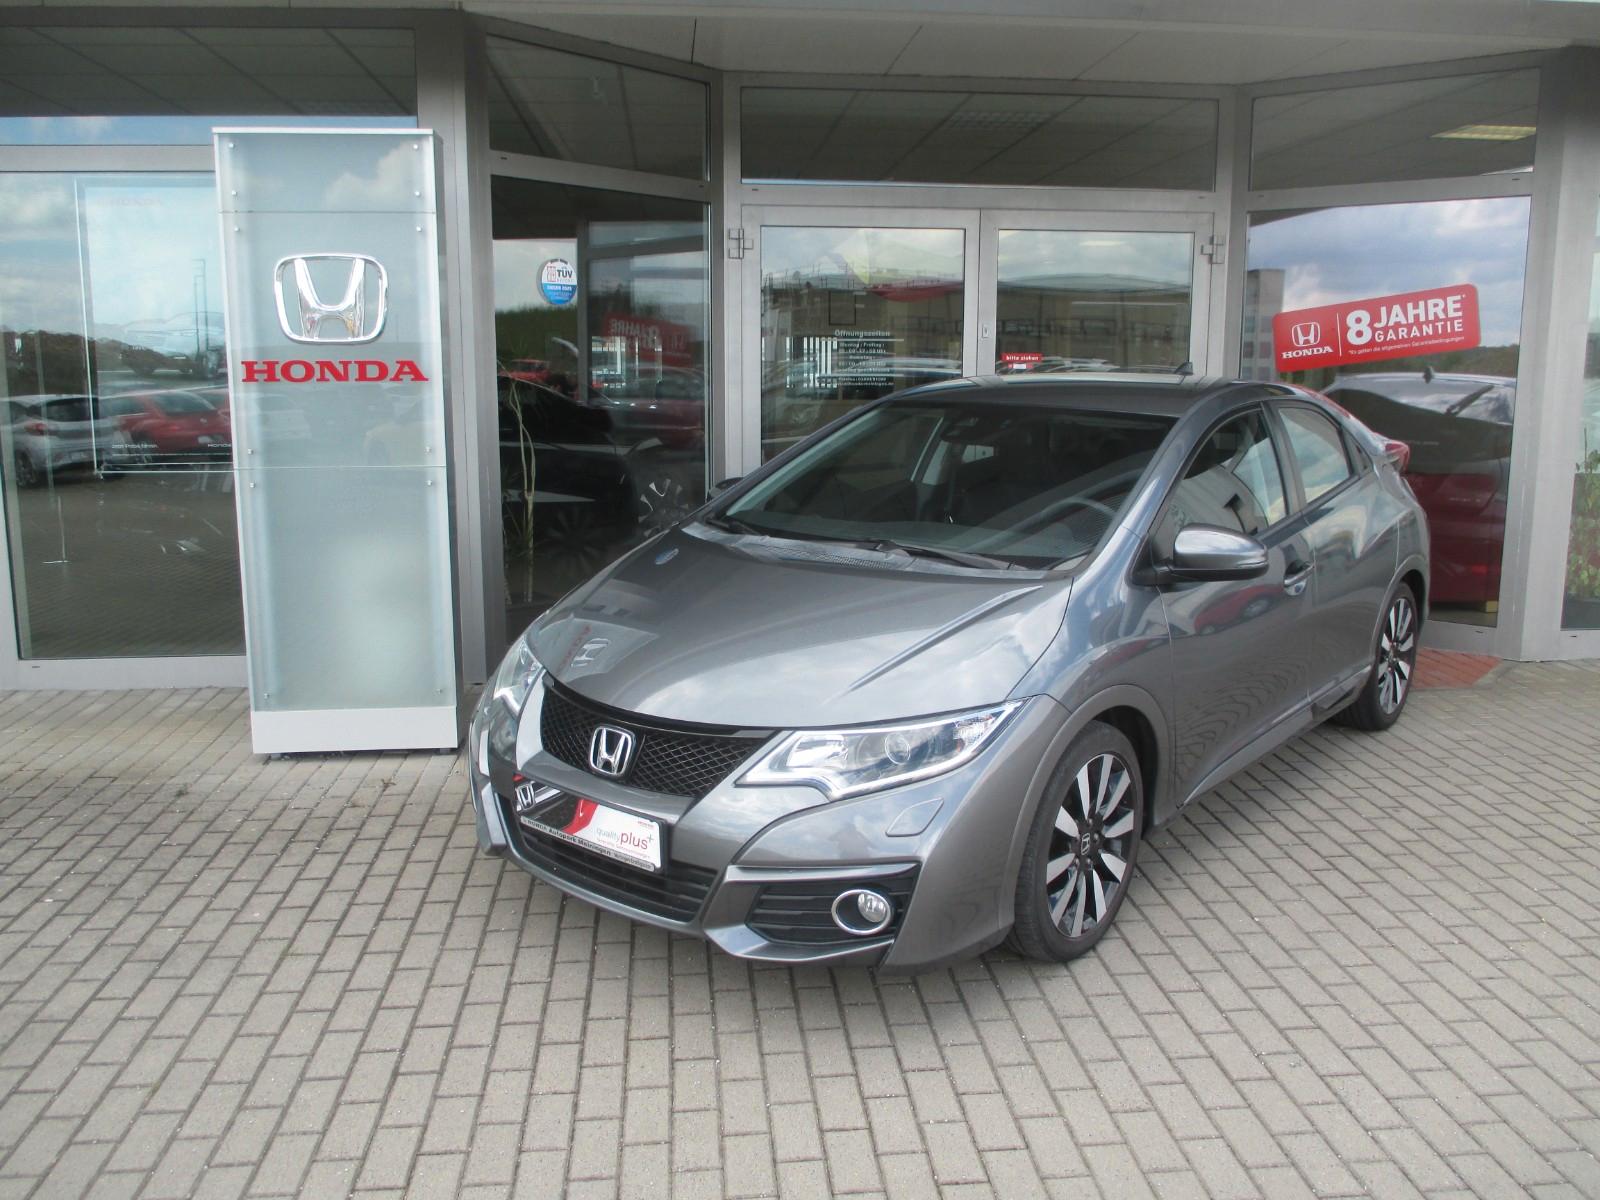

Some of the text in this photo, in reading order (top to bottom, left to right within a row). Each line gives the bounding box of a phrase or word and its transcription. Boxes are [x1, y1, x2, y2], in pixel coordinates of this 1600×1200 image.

[1346, 310, 1372, 345] 8
[1374, 319, 1464, 343] GARANTIE
[1281, 345, 1334, 360] HONDA
[241, 360, 429, 383] HONDA
